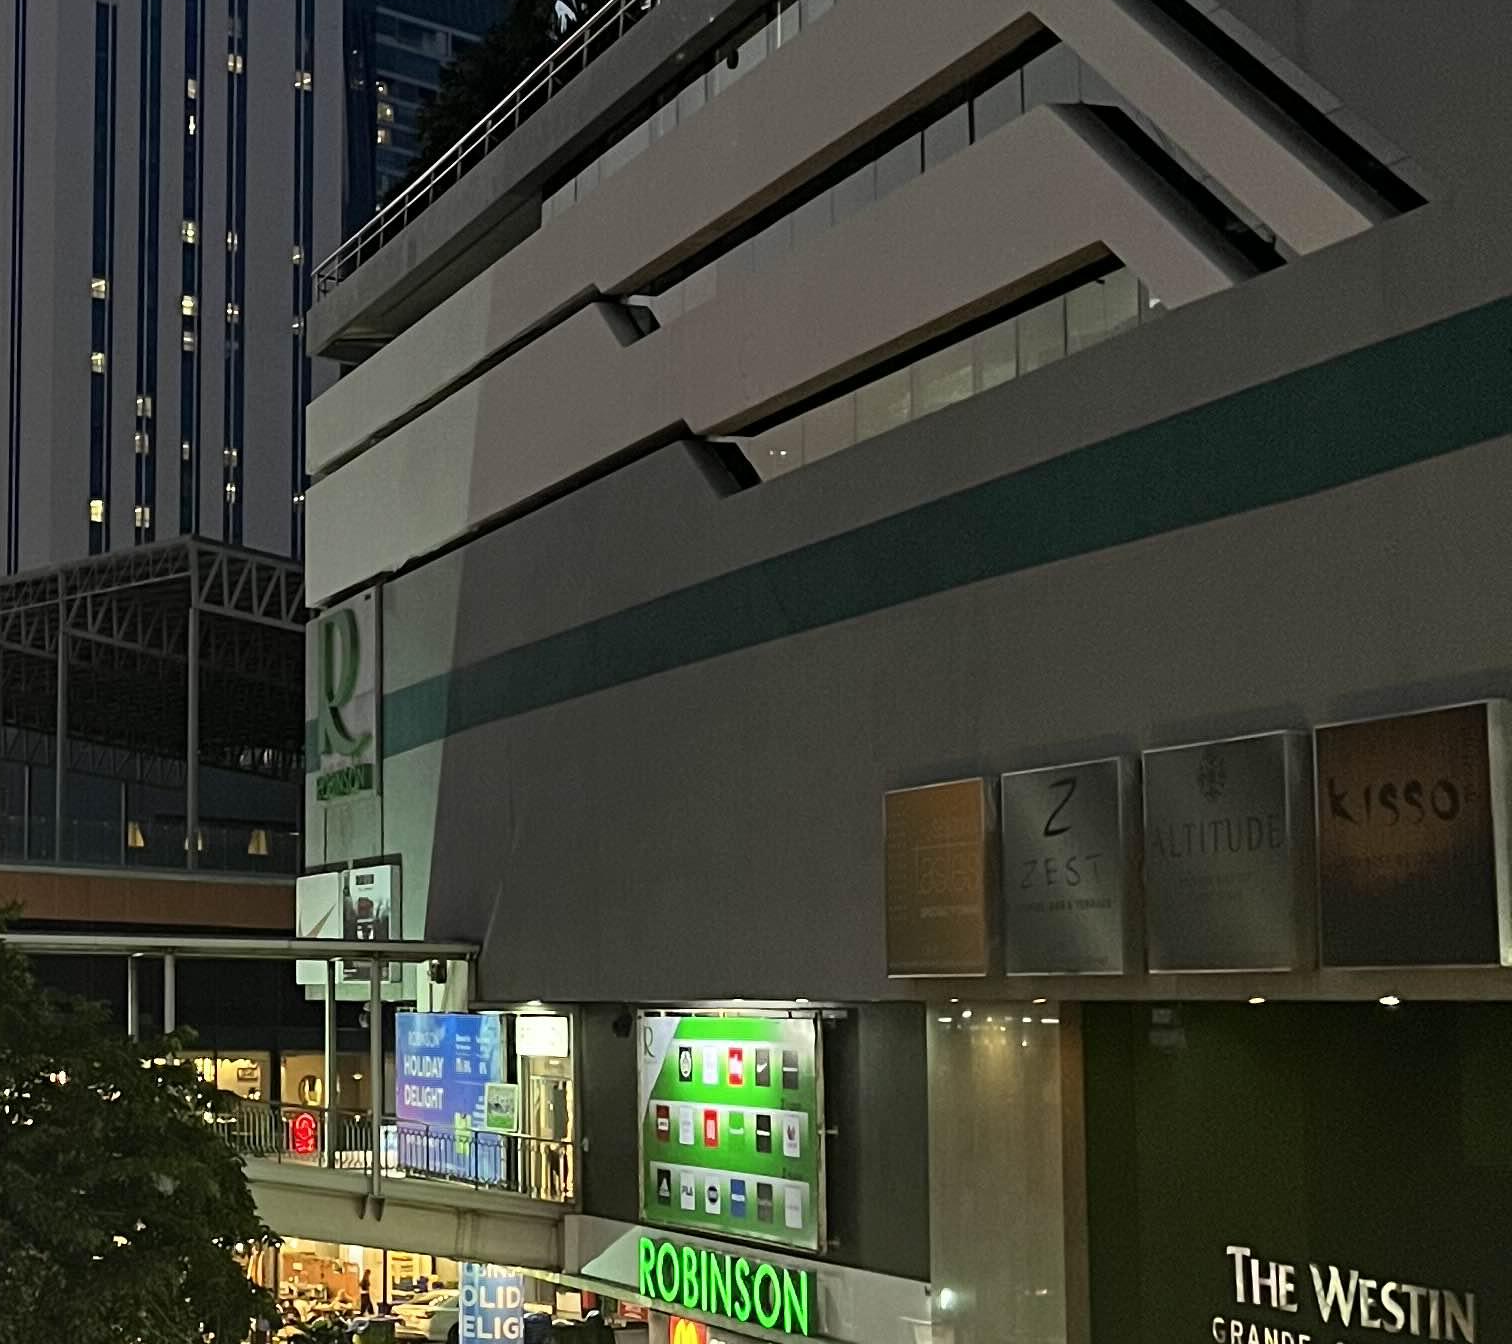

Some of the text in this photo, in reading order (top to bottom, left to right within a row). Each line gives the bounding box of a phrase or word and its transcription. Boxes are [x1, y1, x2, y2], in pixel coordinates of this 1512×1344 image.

[1149, 815, 1287, 859] ALTITUDE
[1019, 852, 1105, 889] ZEST
[403, 1055, 444, 1079] HOLIDAY
[403, 1084, 444, 1110] DELIGHT
[638, 1236, 809, 1337] ROBINSON
[1226, 1244, 1476, 1344] THE WESTIN
